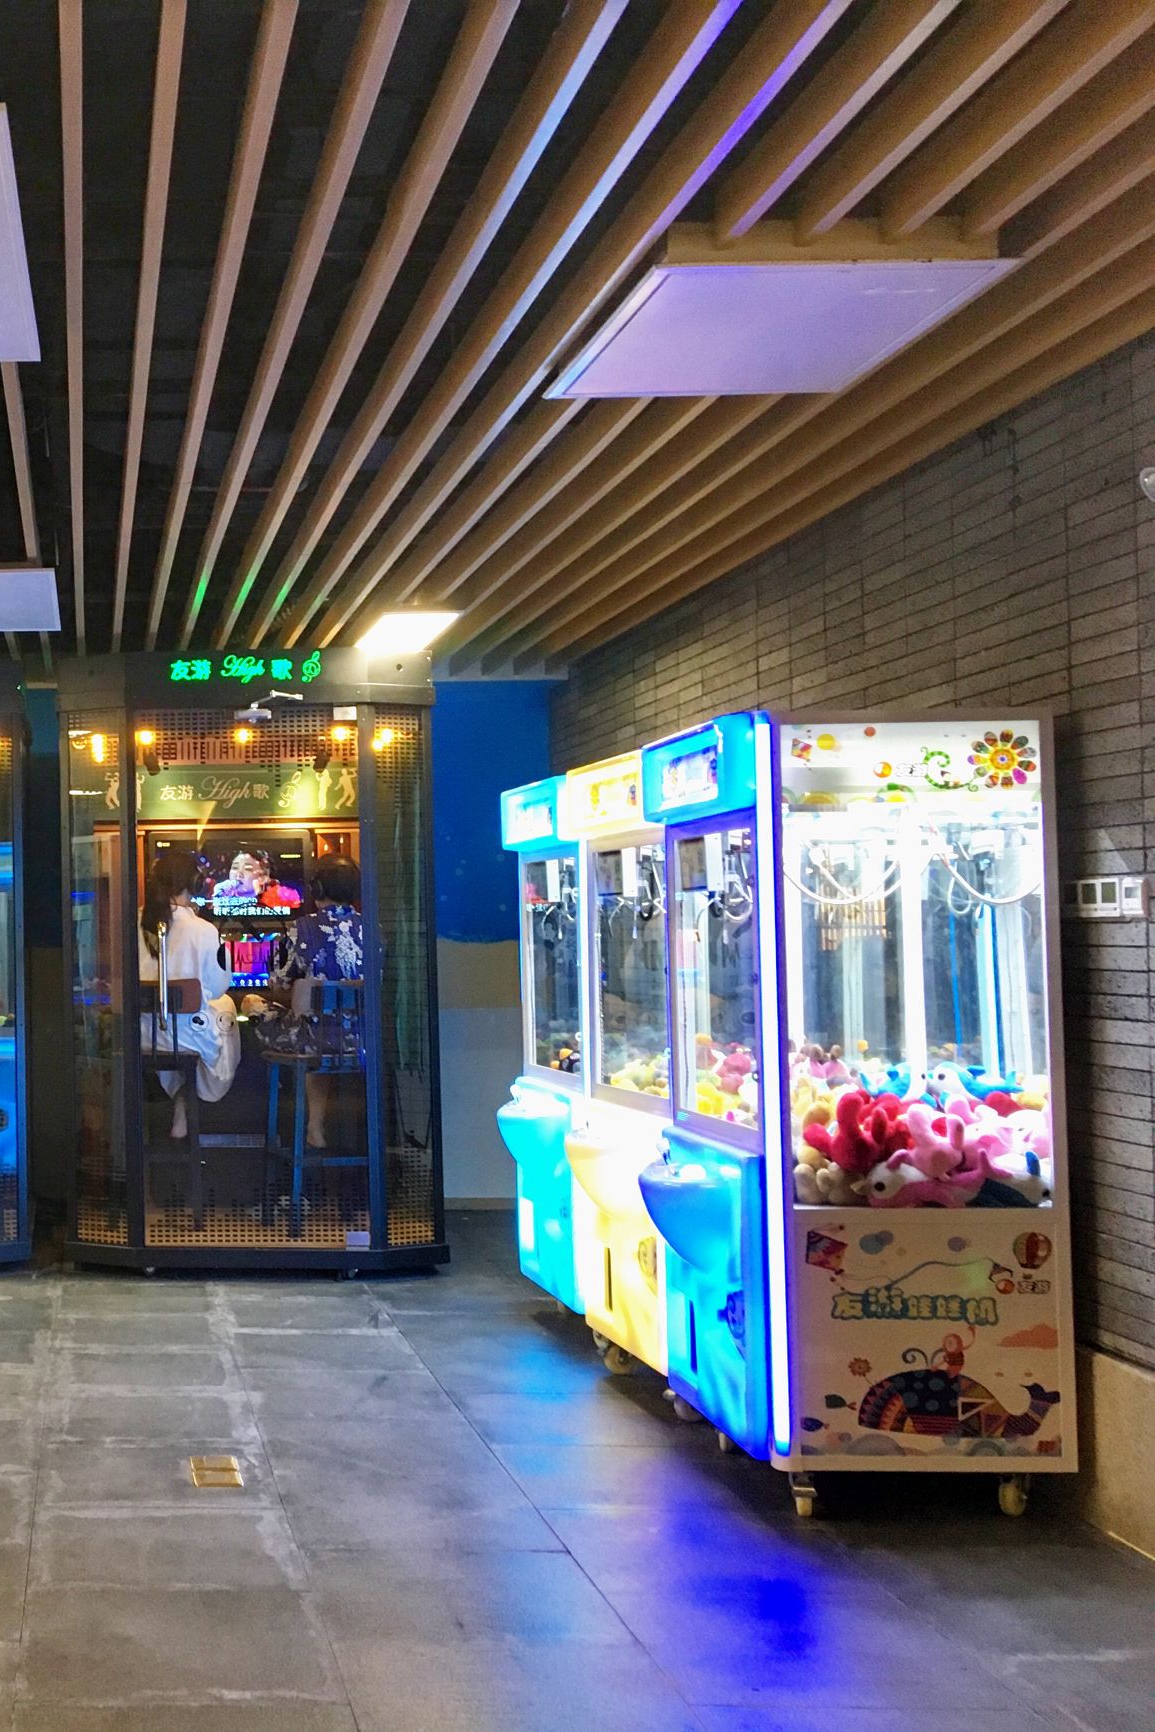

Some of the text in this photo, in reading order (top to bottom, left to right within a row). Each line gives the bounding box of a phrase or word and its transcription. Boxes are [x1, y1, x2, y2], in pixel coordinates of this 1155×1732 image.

[170, 654, 293, 684] 友游 High 歌
[160, 776, 270, 809] 友游 High 歌
